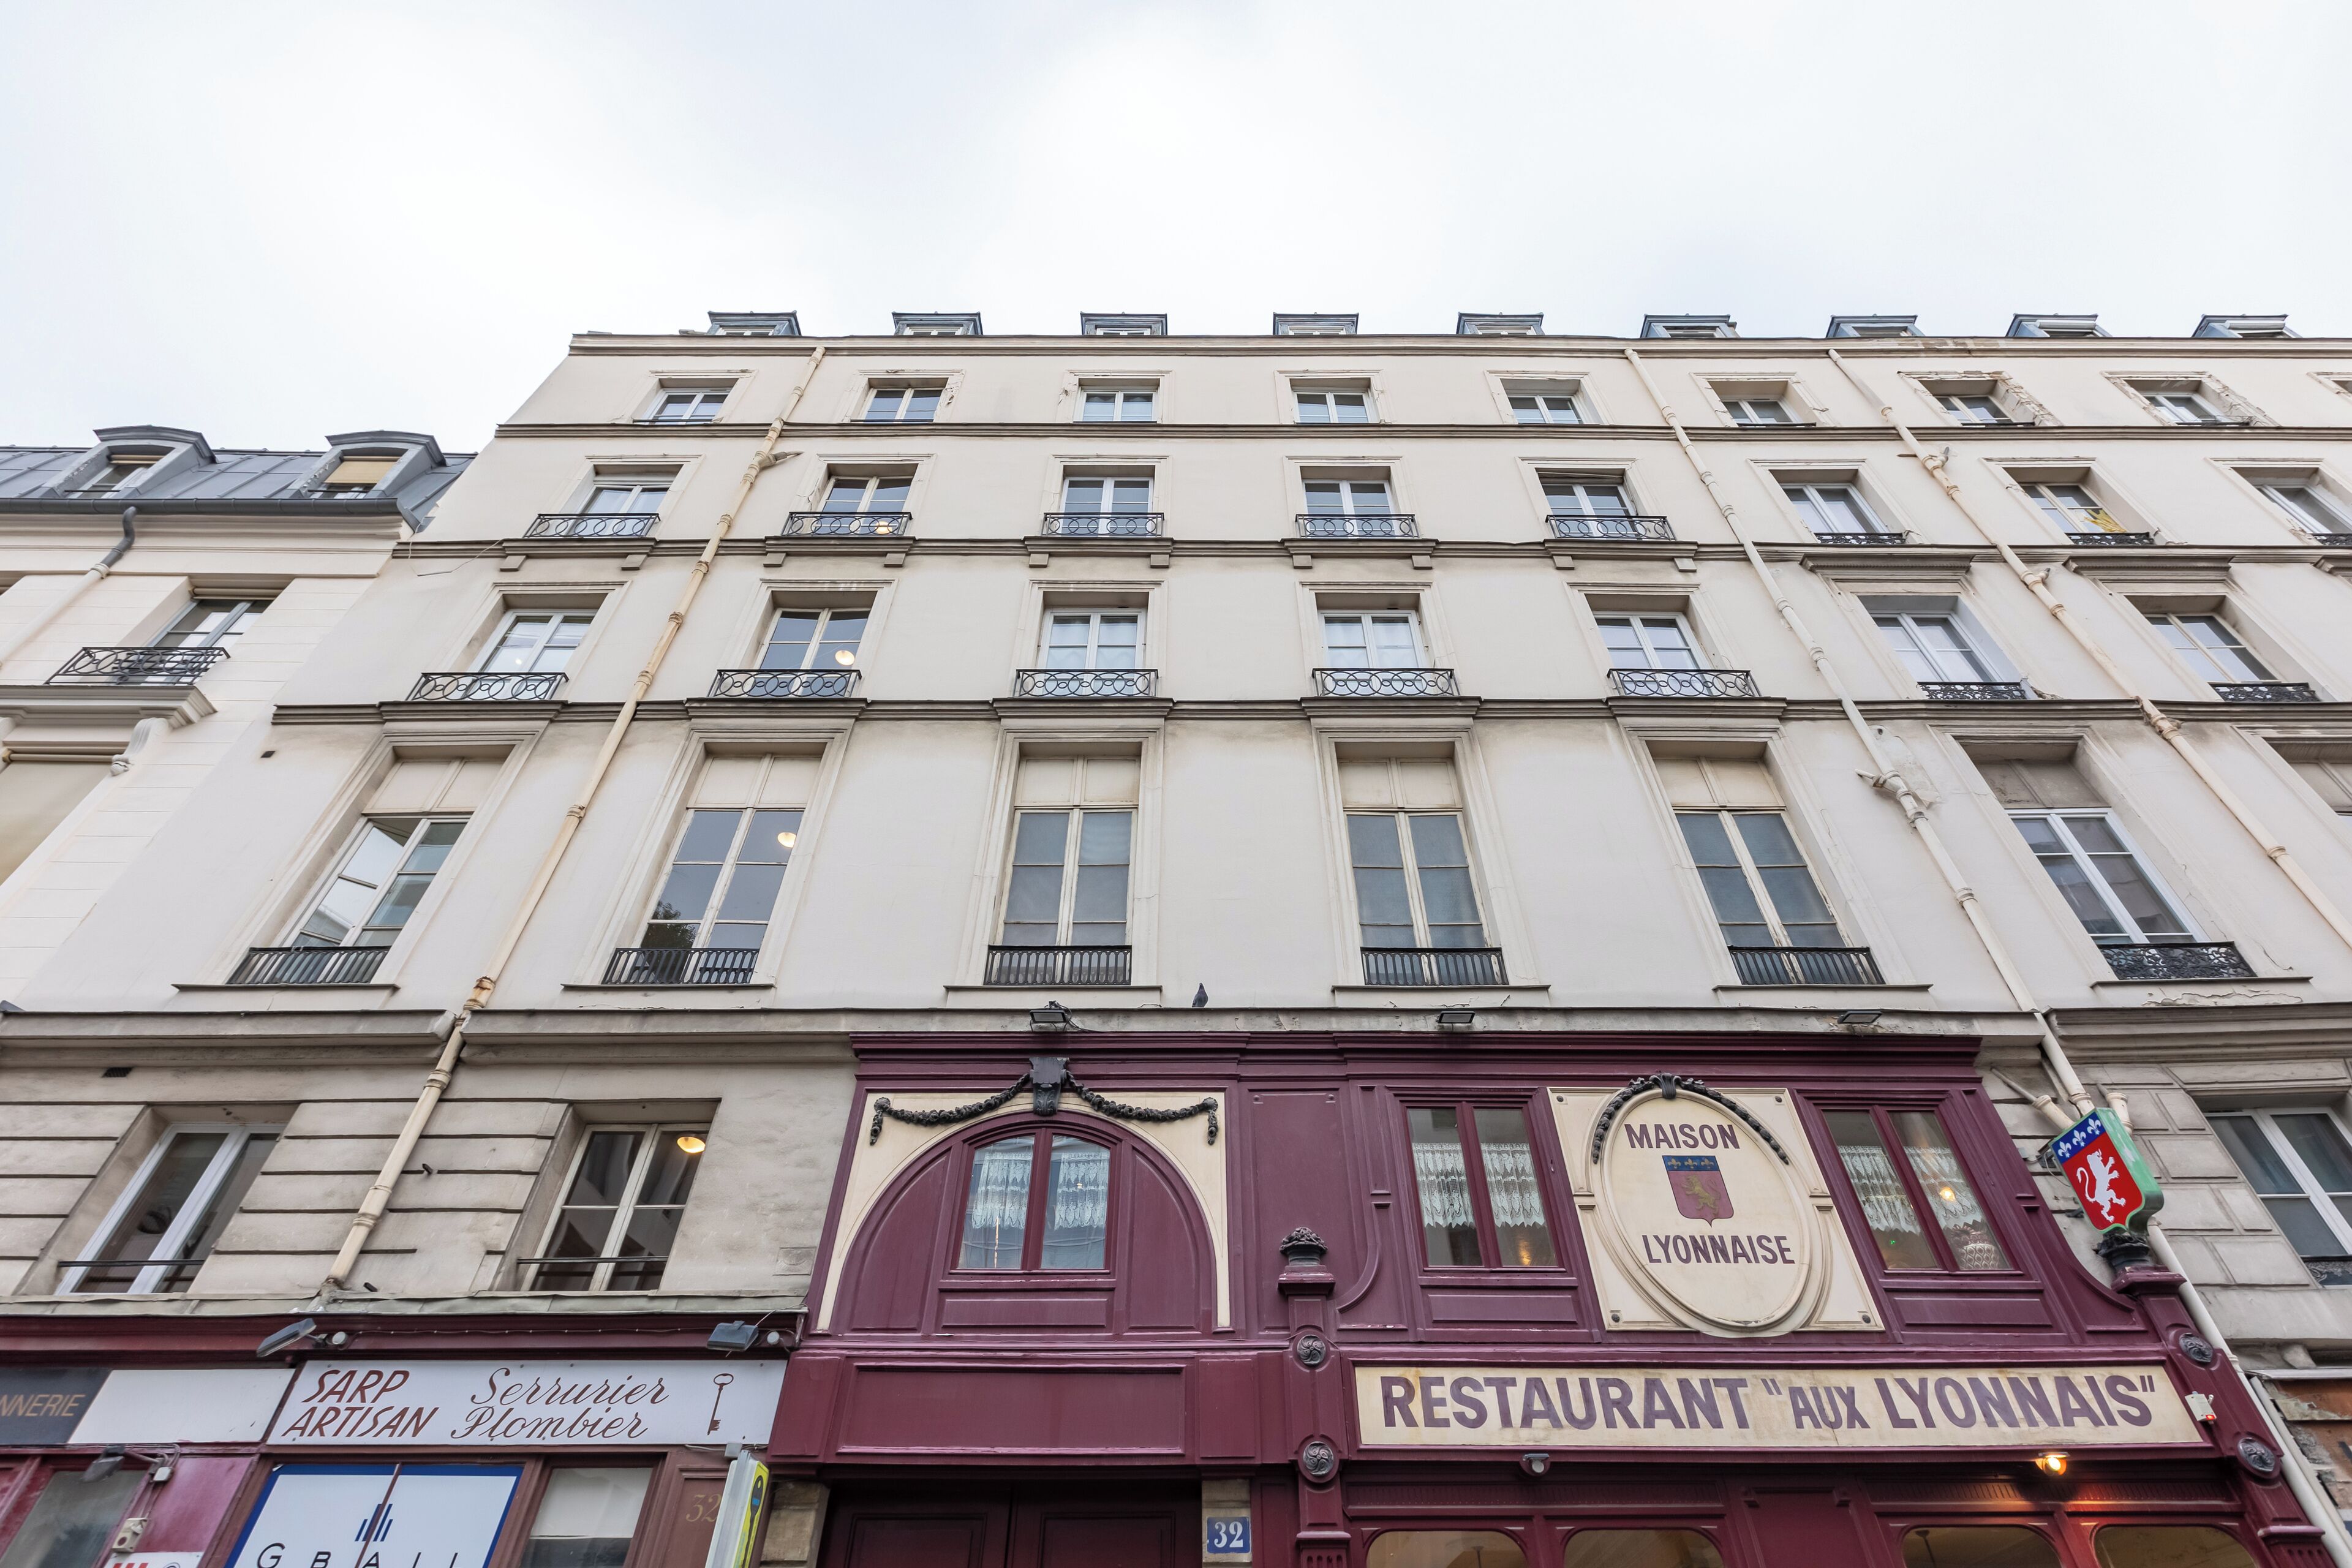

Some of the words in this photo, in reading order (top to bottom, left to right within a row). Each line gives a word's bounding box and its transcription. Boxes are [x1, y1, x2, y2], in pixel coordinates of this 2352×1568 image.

[1624, 1123, 1740, 1149] MAISON
[1642, 1235, 1795, 1264] LYONNAISE
[301, 1370, 410, 1403] SARP
[470, 1367, 669, 1405] Serrurier
[1380, 1376, 1750, 1430] RESTAURANT
[1761, 1378, 1871, 1430] "AUX
[1874, 1374, 2156, 1428] LYONNAIS"
[281, 1406, 440, 1438] ARTISAN
[450, 1405, 648, 1439] Plombier
[1214, 1521, 1243, 1548] 32
